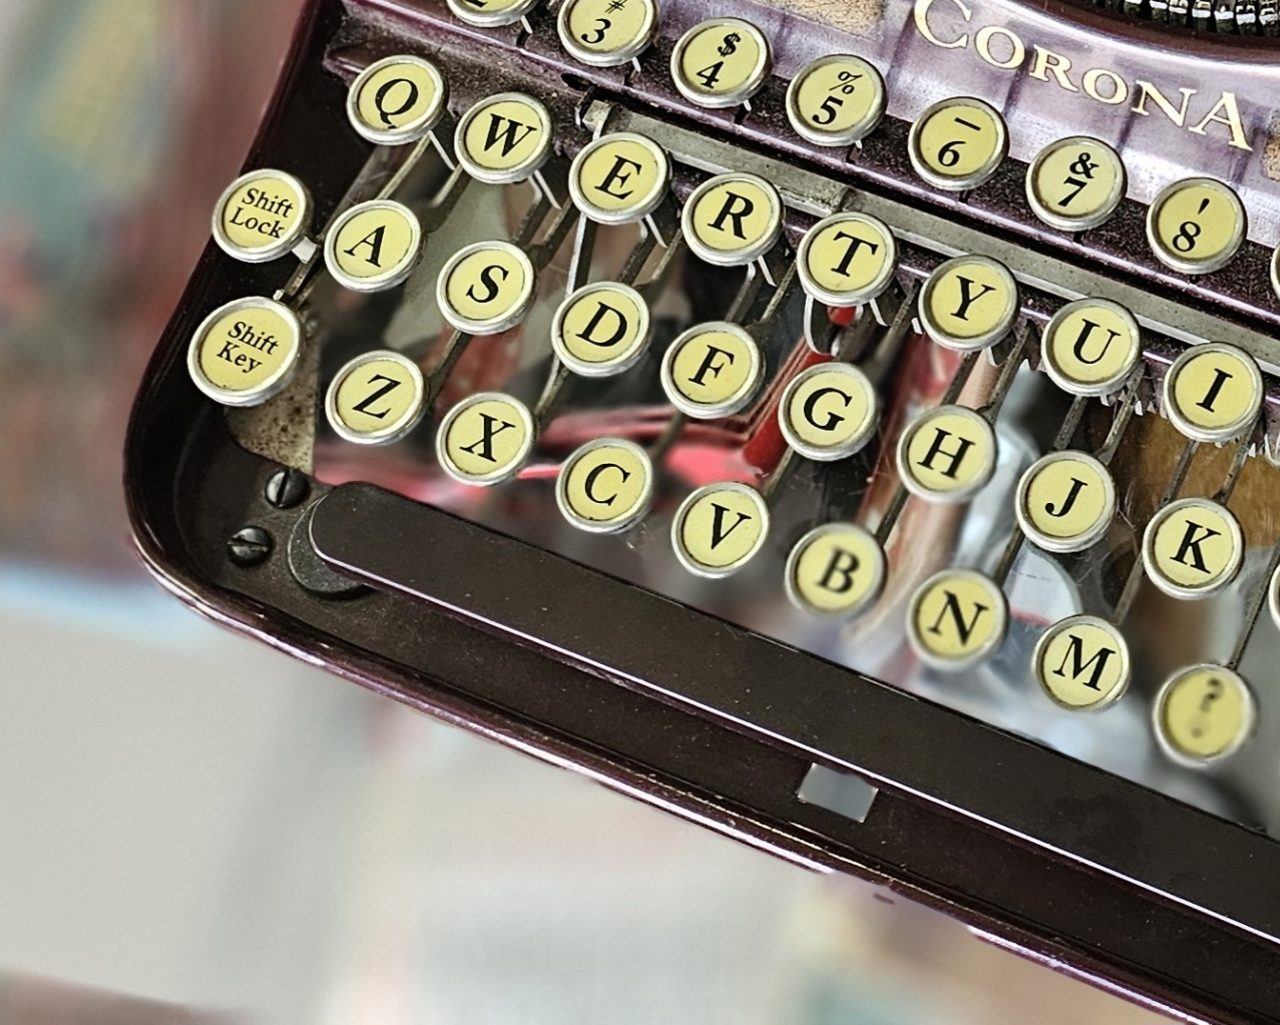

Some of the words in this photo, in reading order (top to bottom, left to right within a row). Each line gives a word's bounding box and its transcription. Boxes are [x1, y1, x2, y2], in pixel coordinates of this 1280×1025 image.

[580, 18, 612, 44] 3
[717, 32, 742, 58] $
[696, 60, 724, 89] 4
[374, 78, 418, 130] Q
[811, 95, 844, 125] 5
[483, 113, 537, 158] W
[937, 140, 966, 168] 6
[594, 154, 642, 200] E
[1069, 152, 1100, 179] &
[241, 188, 293, 218] Shift
[1057, 176, 1088, 208] 7
[229, 207, 286, 240] Lock
[707, 190, 754, 240] R
[1171, 221, 1202, 253] 8
[343, 224, 386, 268] A
[830, 230, 879, 278] T
[465, 264, 509, 304] S
[950, 275, 996, 321] Y
[227, 321, 279, 355] Shift
[575, 301, 628, 347] D
[1073, 318, 1121, 365] U
[216, 340, 263, 374] Key
[688, 344, 735, 387] F
[352, 374, 402, 419] Z
[803, 387, 853, 431] G
[1195, 368, 1233, 413] I
[459, 412, 516, 463] X
[916, 427, 975, 479] H
[584, 463, 631, 507] C
[1044, 477, 1088, 518] J
[710, 502, 752, 550] V
[1169, 519, 1222, 574] K
[818, 549, 860, 594] B
[929, 591, 988, 645] N
[1052, 634, 1116, 692] M
